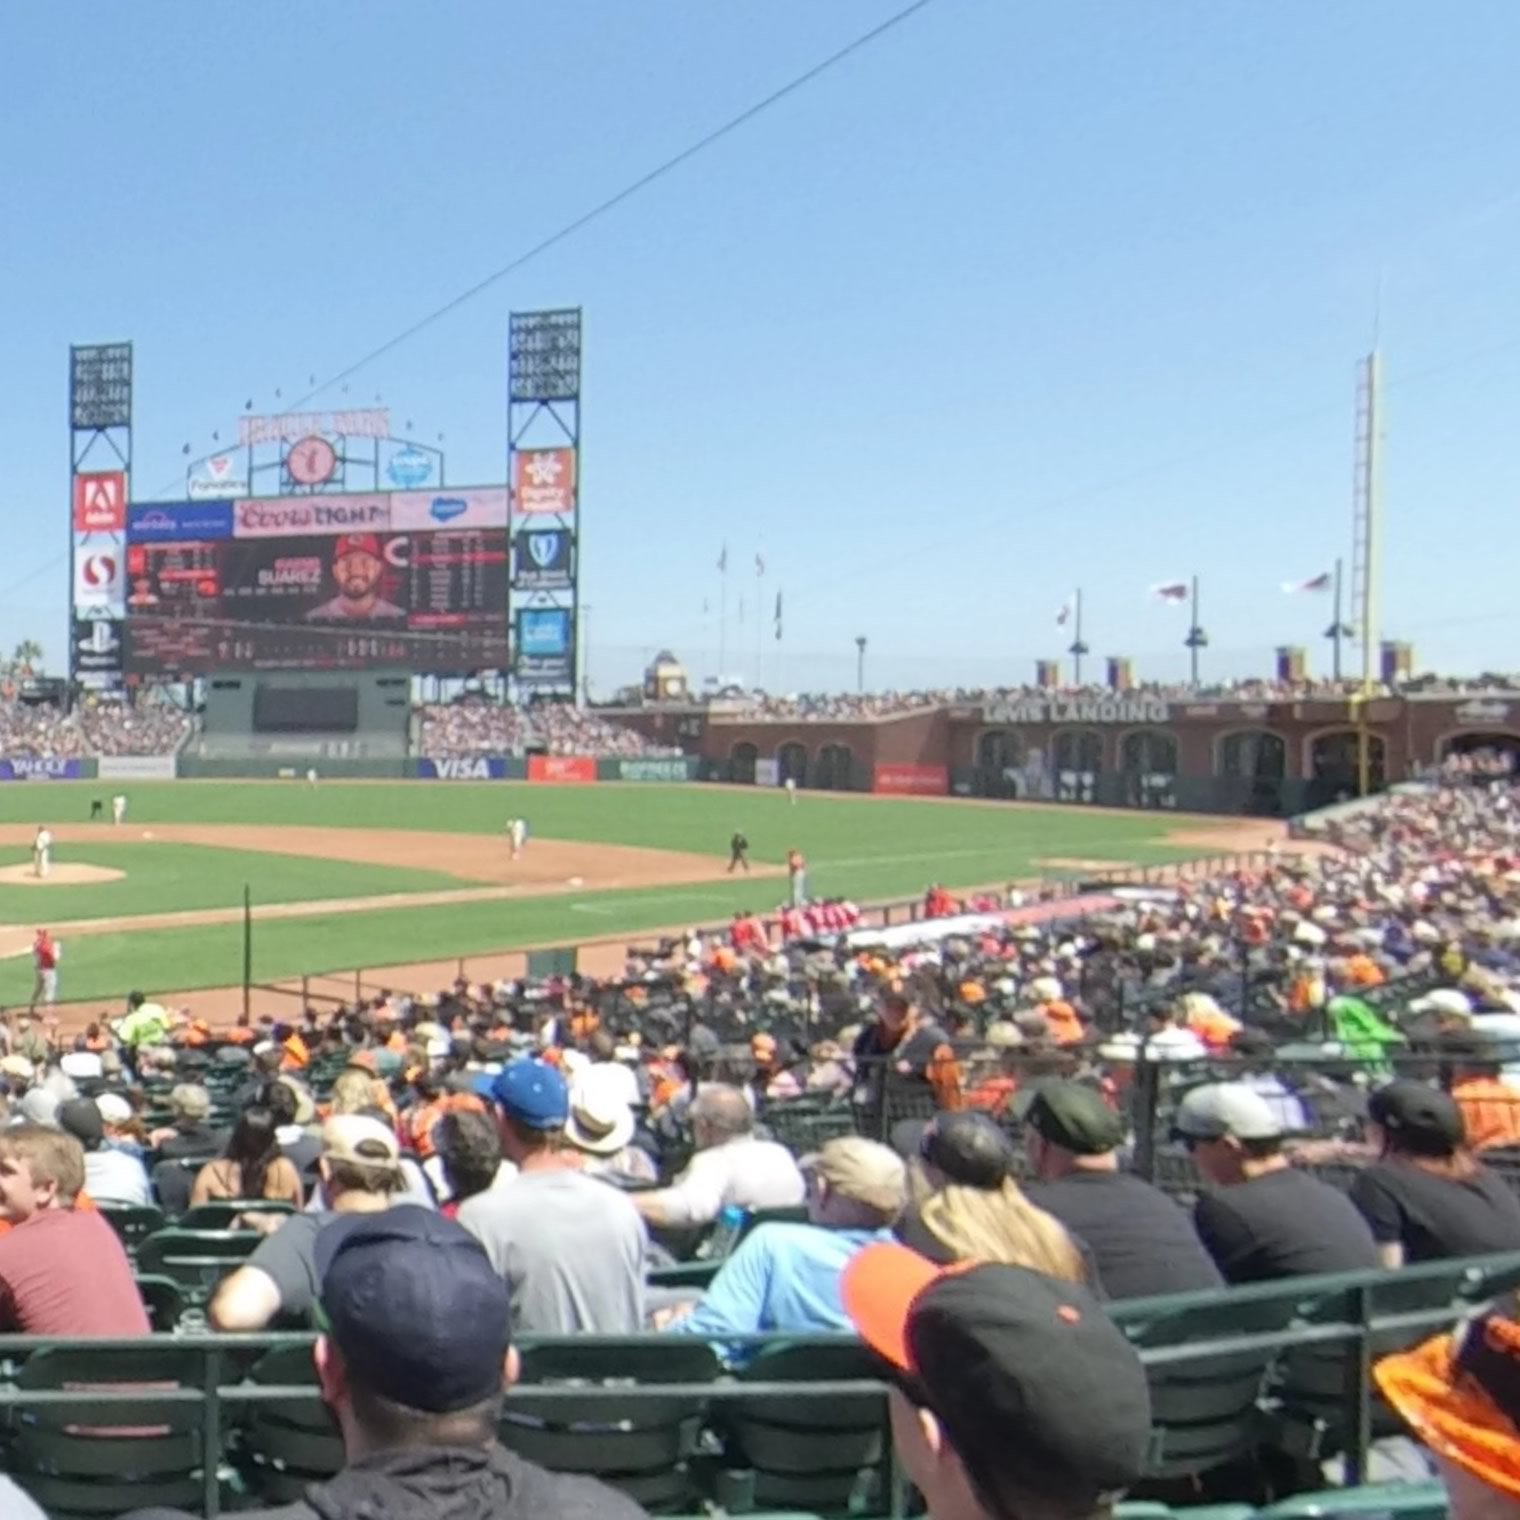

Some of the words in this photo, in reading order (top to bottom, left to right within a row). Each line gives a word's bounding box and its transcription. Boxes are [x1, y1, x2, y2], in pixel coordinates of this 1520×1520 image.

[313, 505, 379, 525] LIGHT
[1049, 702, 1169, 723] LANDING
[435, 759, 491, 779] VISA
